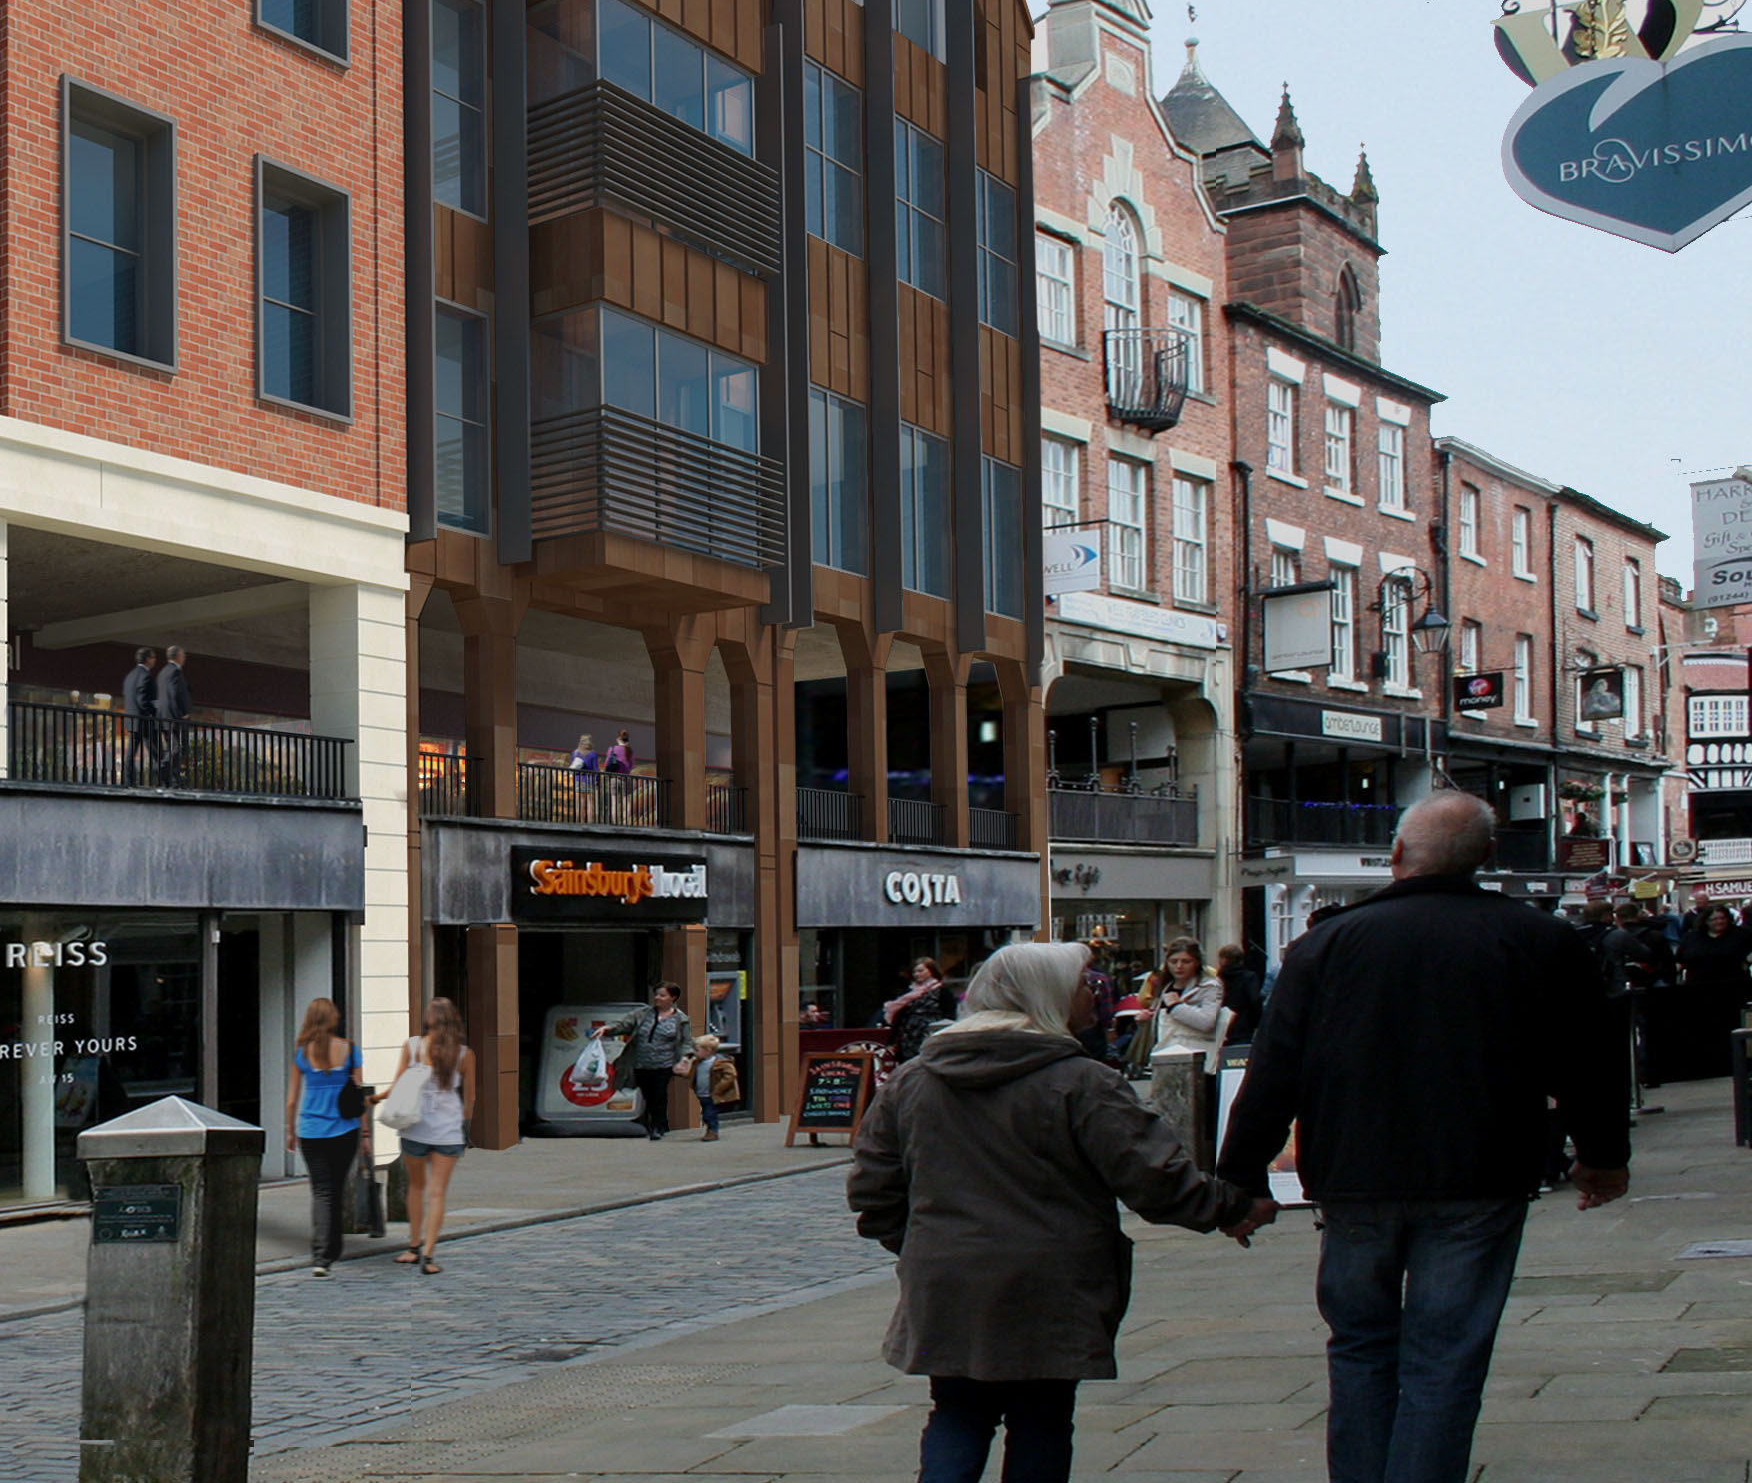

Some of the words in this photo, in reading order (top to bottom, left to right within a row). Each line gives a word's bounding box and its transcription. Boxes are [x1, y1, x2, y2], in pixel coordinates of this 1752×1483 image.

[1560, 133, 1752, 182] BRAVISSIM
[1459, 695, 1497, 706] money
[530, 860, 654, 904] Sainsbury's
[886, 871, 961, 907] COSTA
[5, 941, 108, 968] REISS
[38, 1013, 75, 1025] REISS
[75, 1036, 138, 1054] YOURS
[61, 1073, 74, 1083] 15
